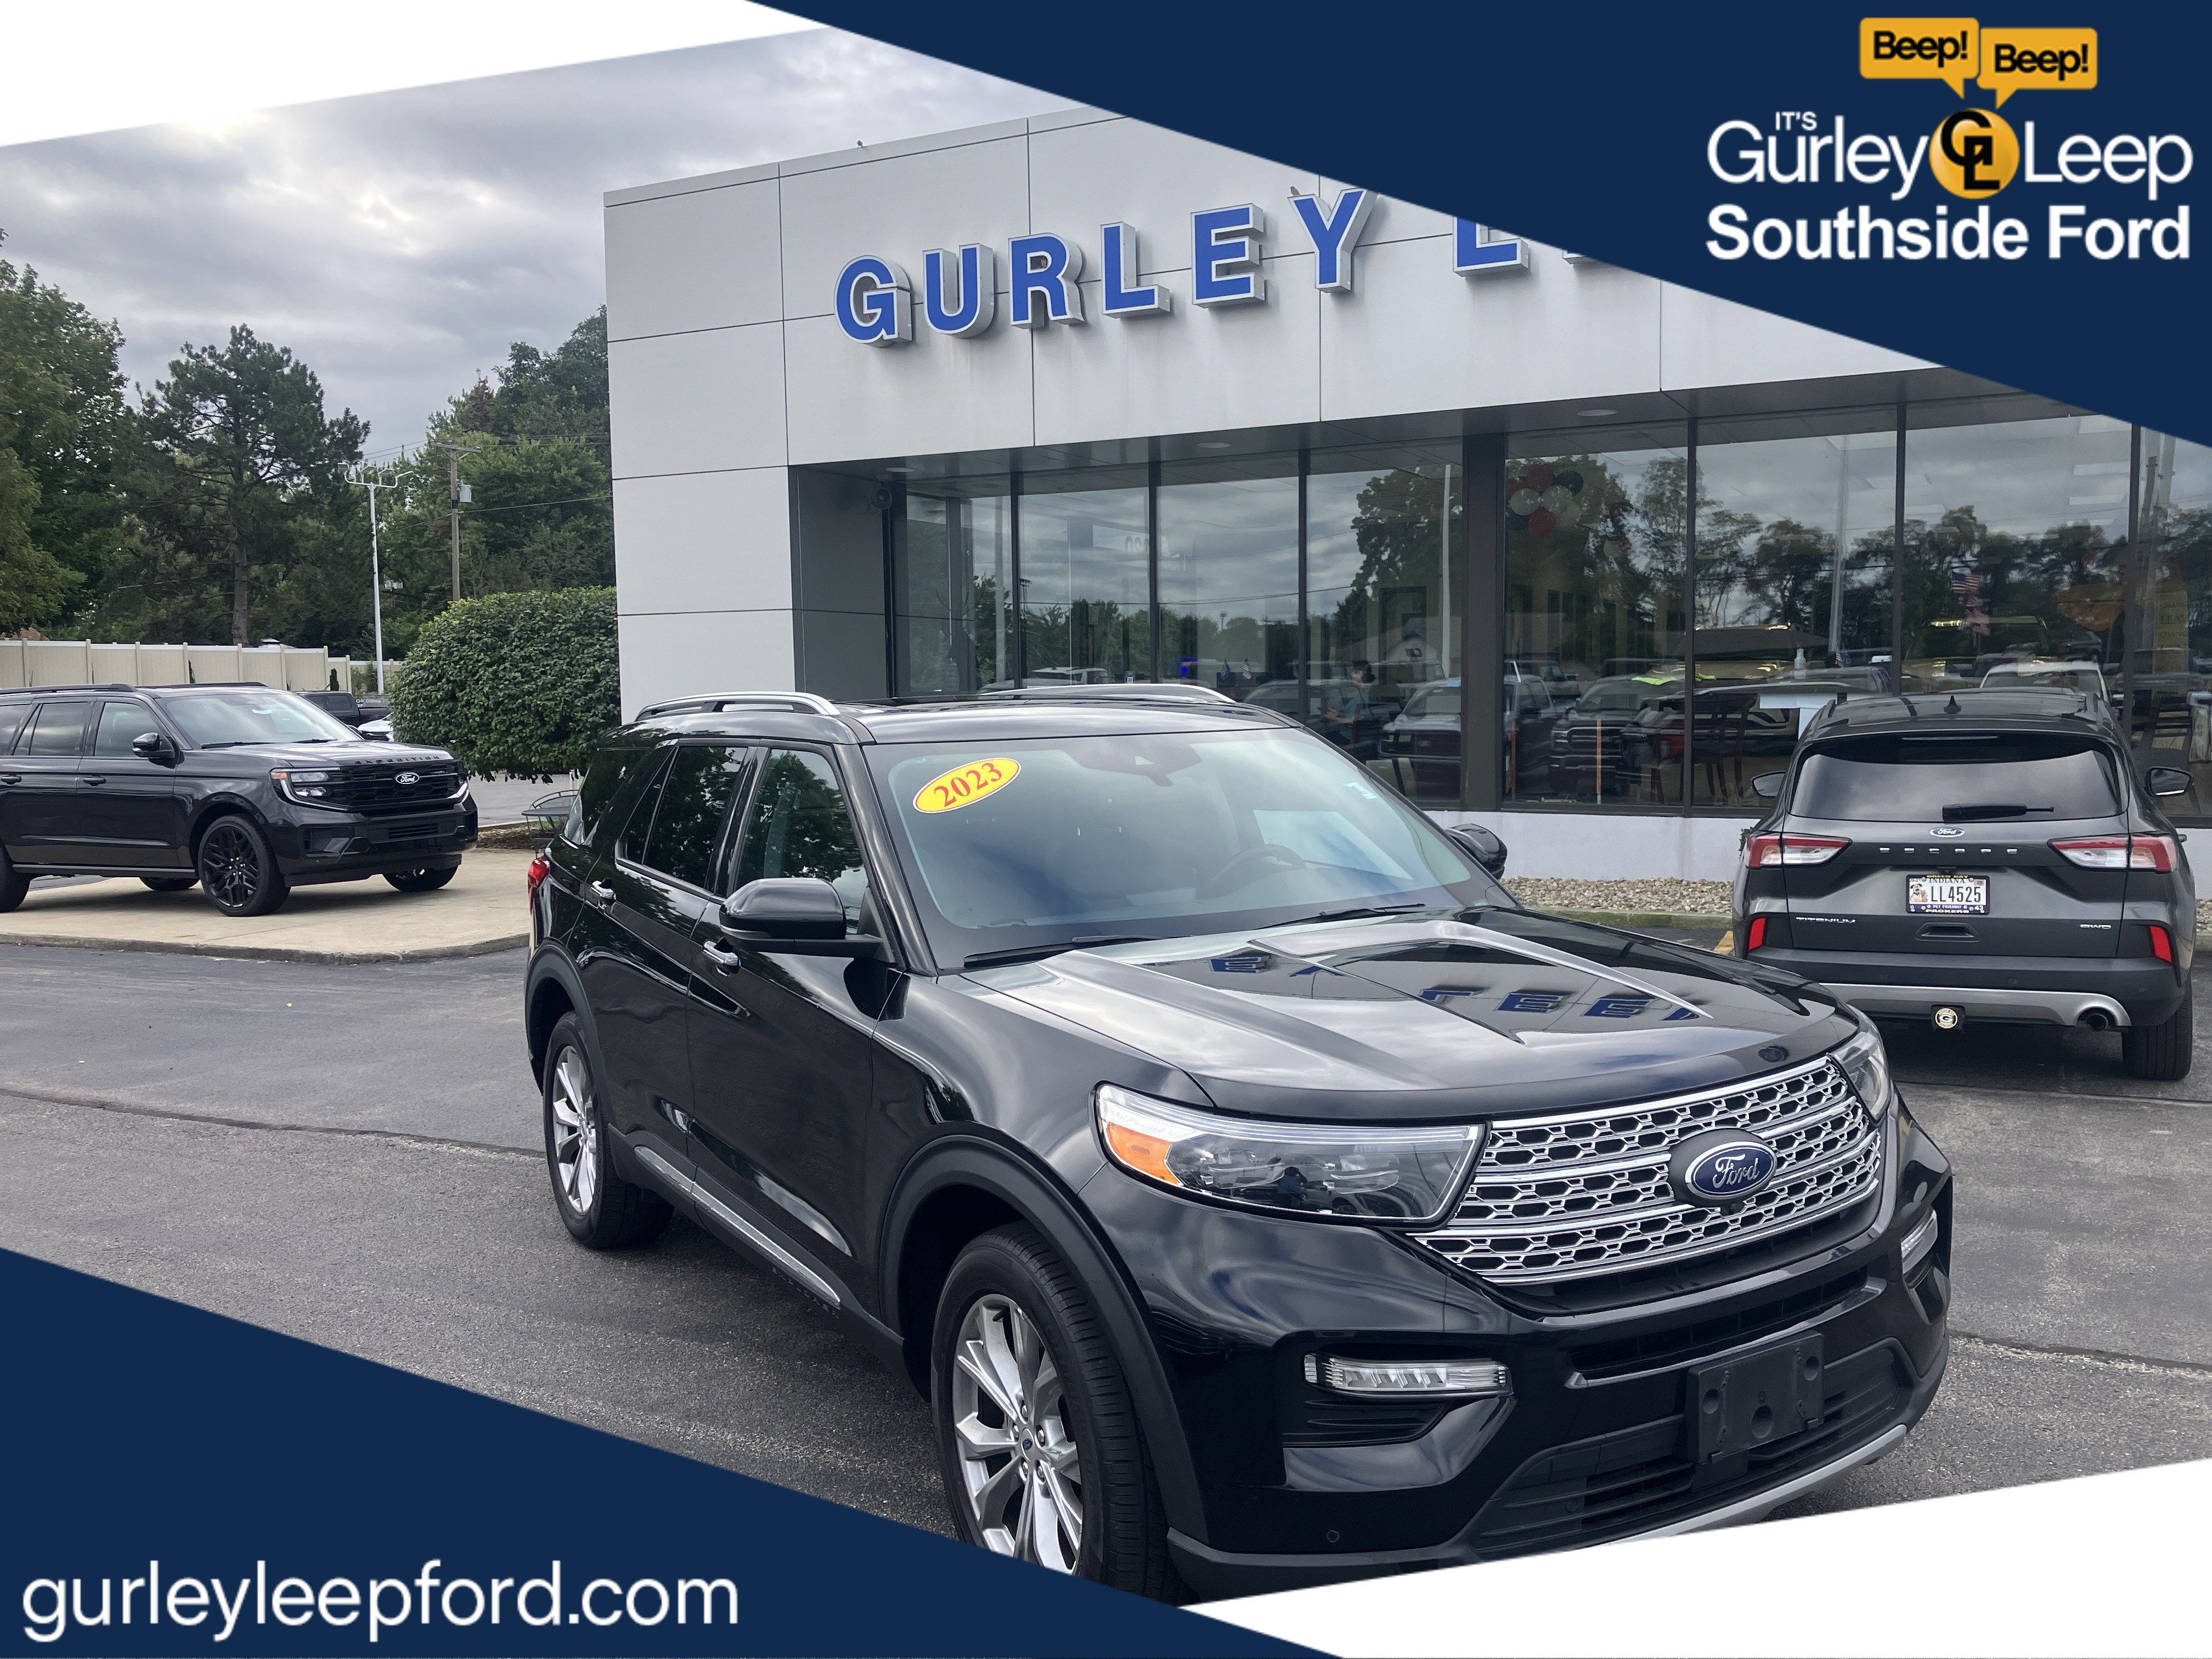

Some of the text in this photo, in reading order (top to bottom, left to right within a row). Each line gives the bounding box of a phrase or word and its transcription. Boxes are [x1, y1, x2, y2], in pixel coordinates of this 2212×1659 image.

[834, 187, 1378, 347] GURLEY
[400, 774, 415, 783] Ford
[934, 763, 1002, 807] 2023
[1931, 885, 1981, 903] LL4525
[1712, 1153, 1760, 1189] Ford
